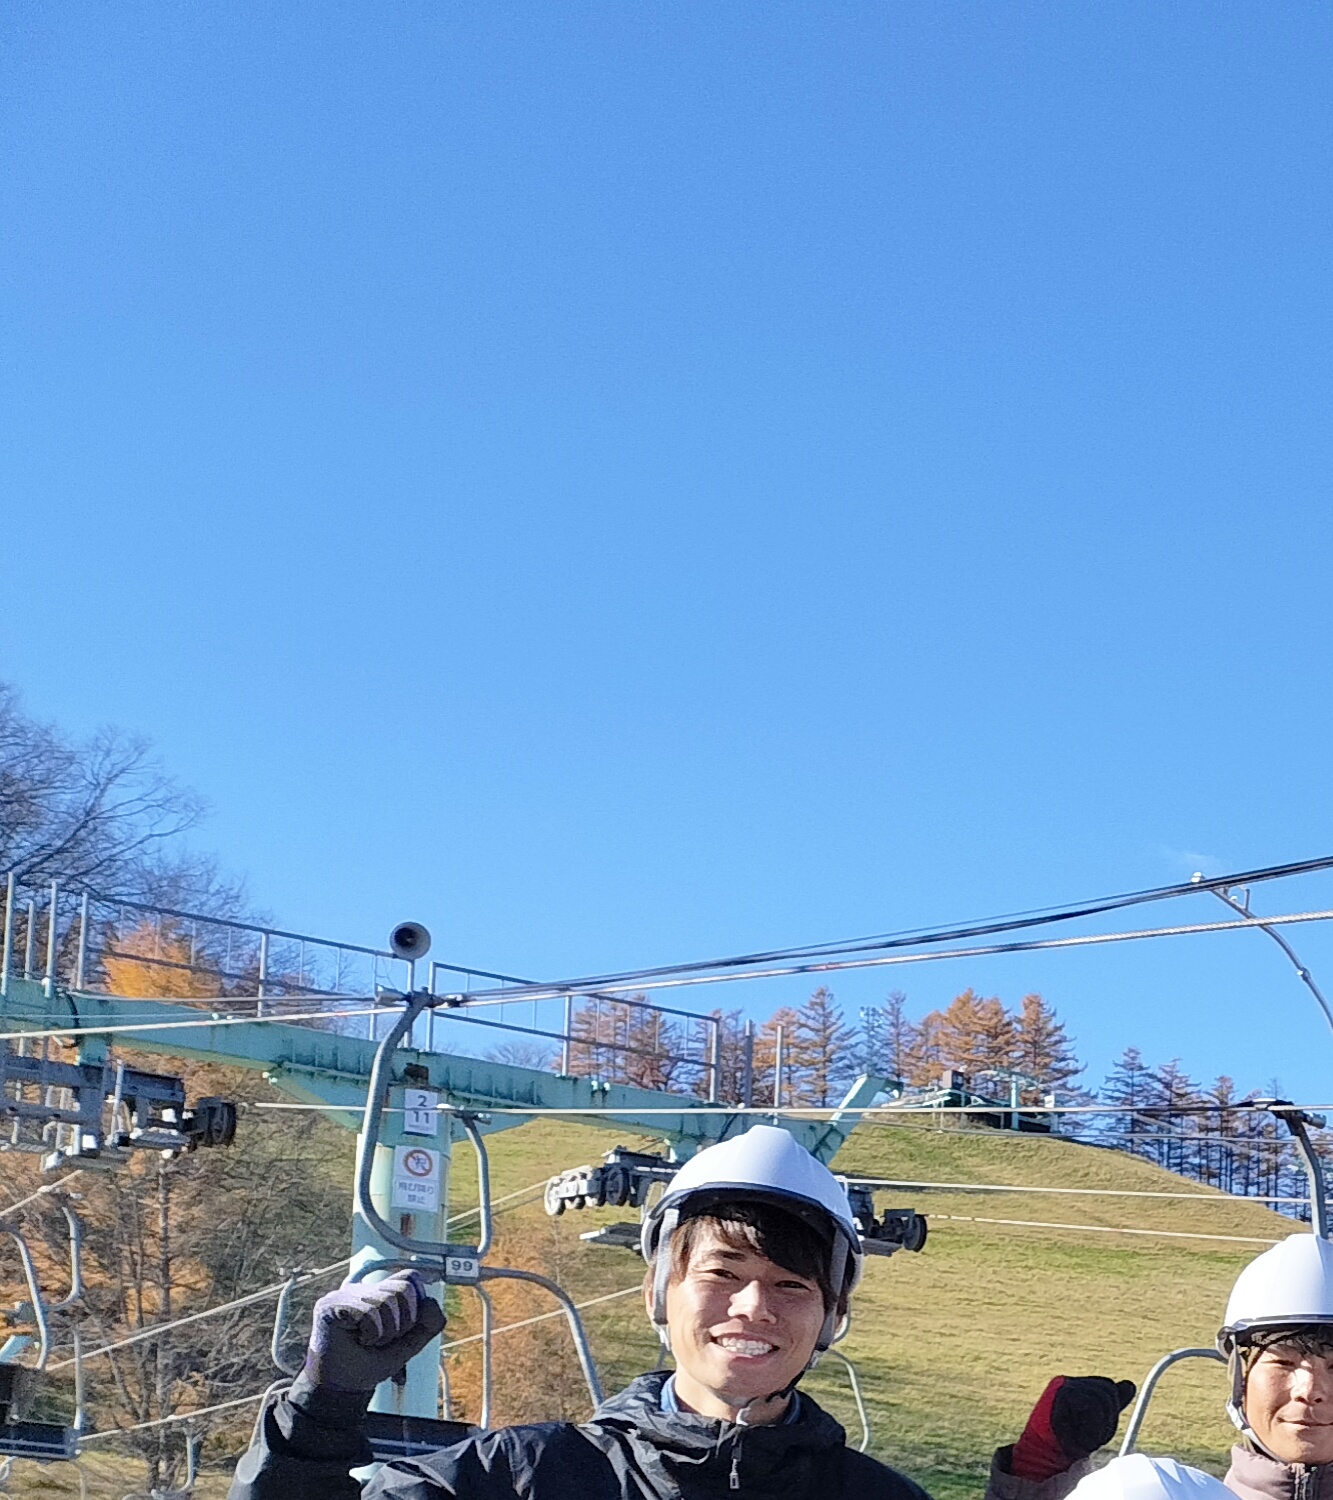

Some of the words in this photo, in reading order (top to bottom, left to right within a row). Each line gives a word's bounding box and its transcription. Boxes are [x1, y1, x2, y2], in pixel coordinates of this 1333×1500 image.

[417, 1094, 428, 1108] 2
[413, 1111, 430, 1124] 11
[450, 1260, 473, 1271] 99
